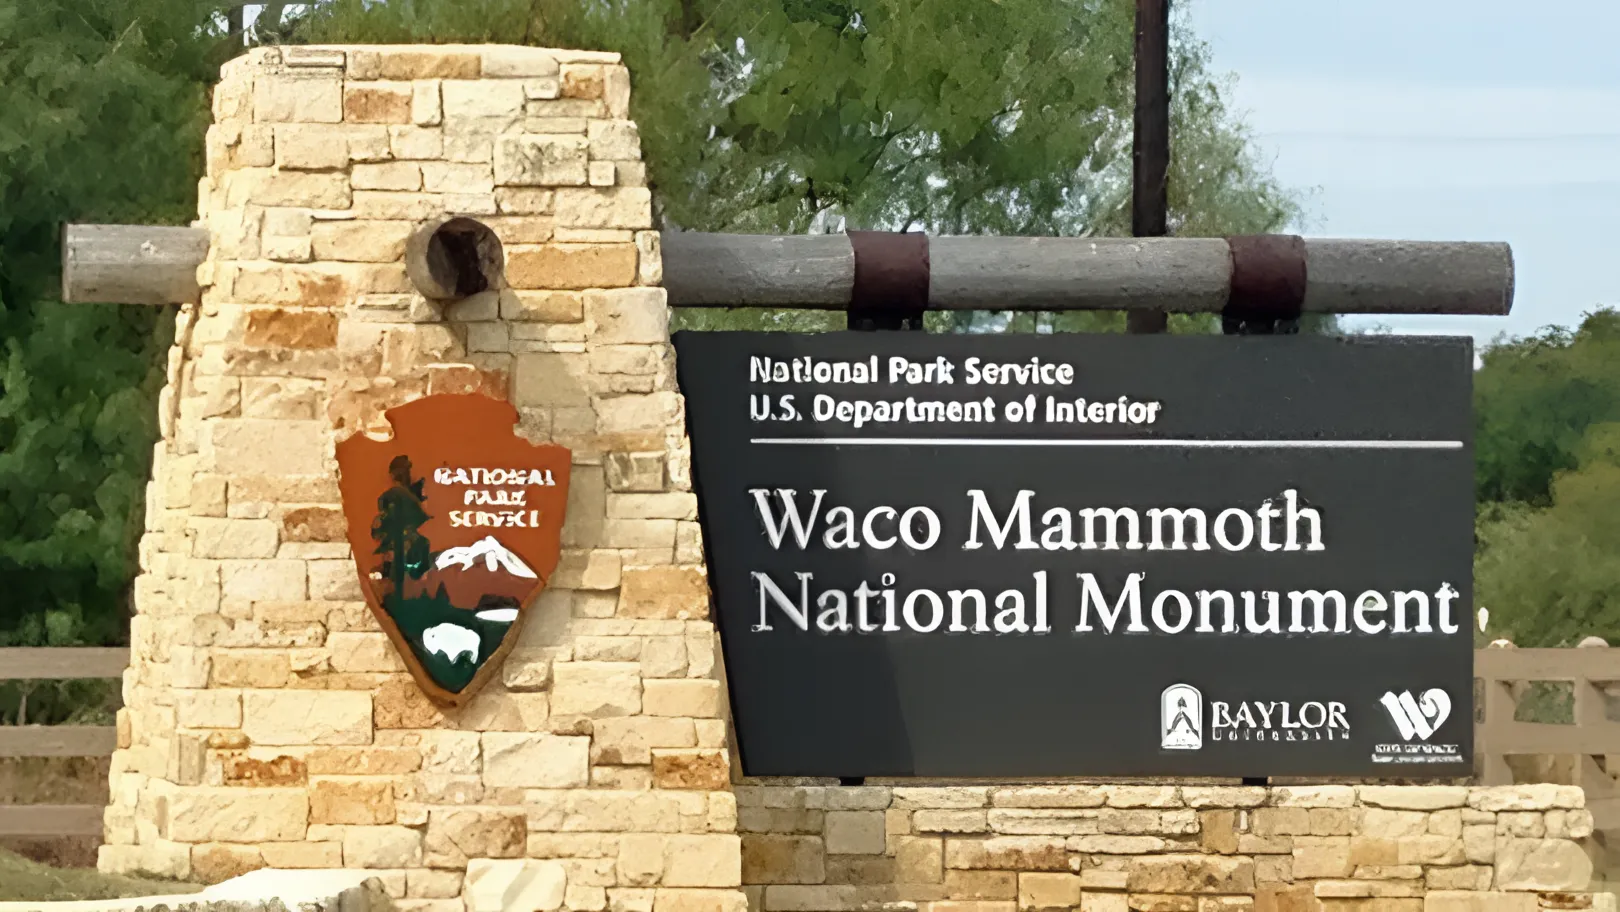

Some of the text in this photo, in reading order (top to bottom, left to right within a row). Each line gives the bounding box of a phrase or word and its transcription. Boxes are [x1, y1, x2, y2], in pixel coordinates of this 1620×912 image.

[751, 355, 1074, 385] National Park Service
[751, 394, 1161, 428] U.S. Department of Interior
[749, 489, 1325, 552] Waco Mammoth
[751, 571, 1459, 635] National Monument
[1211, 701, 1350, 729] BAYLOR
